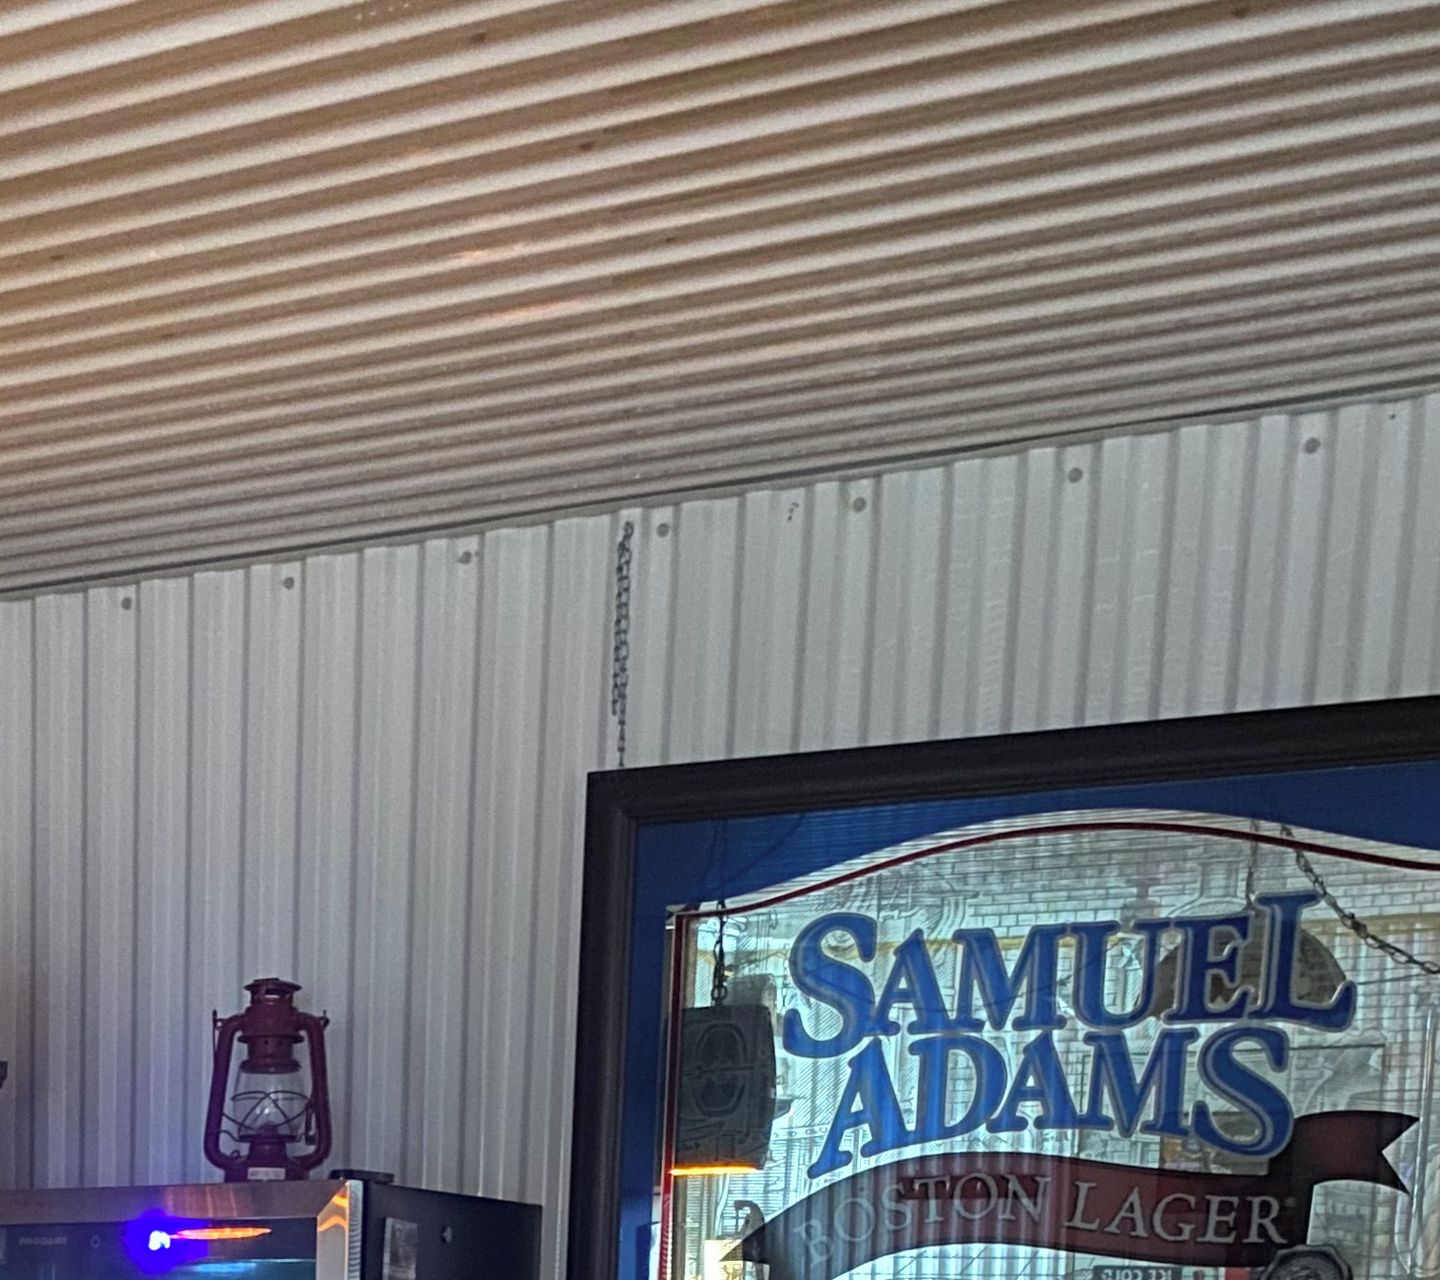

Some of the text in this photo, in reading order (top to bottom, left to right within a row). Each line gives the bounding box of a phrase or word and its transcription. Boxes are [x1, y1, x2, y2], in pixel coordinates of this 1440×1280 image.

[783, 891, 1357, 1058] SAMUEL
[807, 1023, 1295, 1179] ADAMS
[794, 1172, 1288, 1264] BOSTON LAGER
